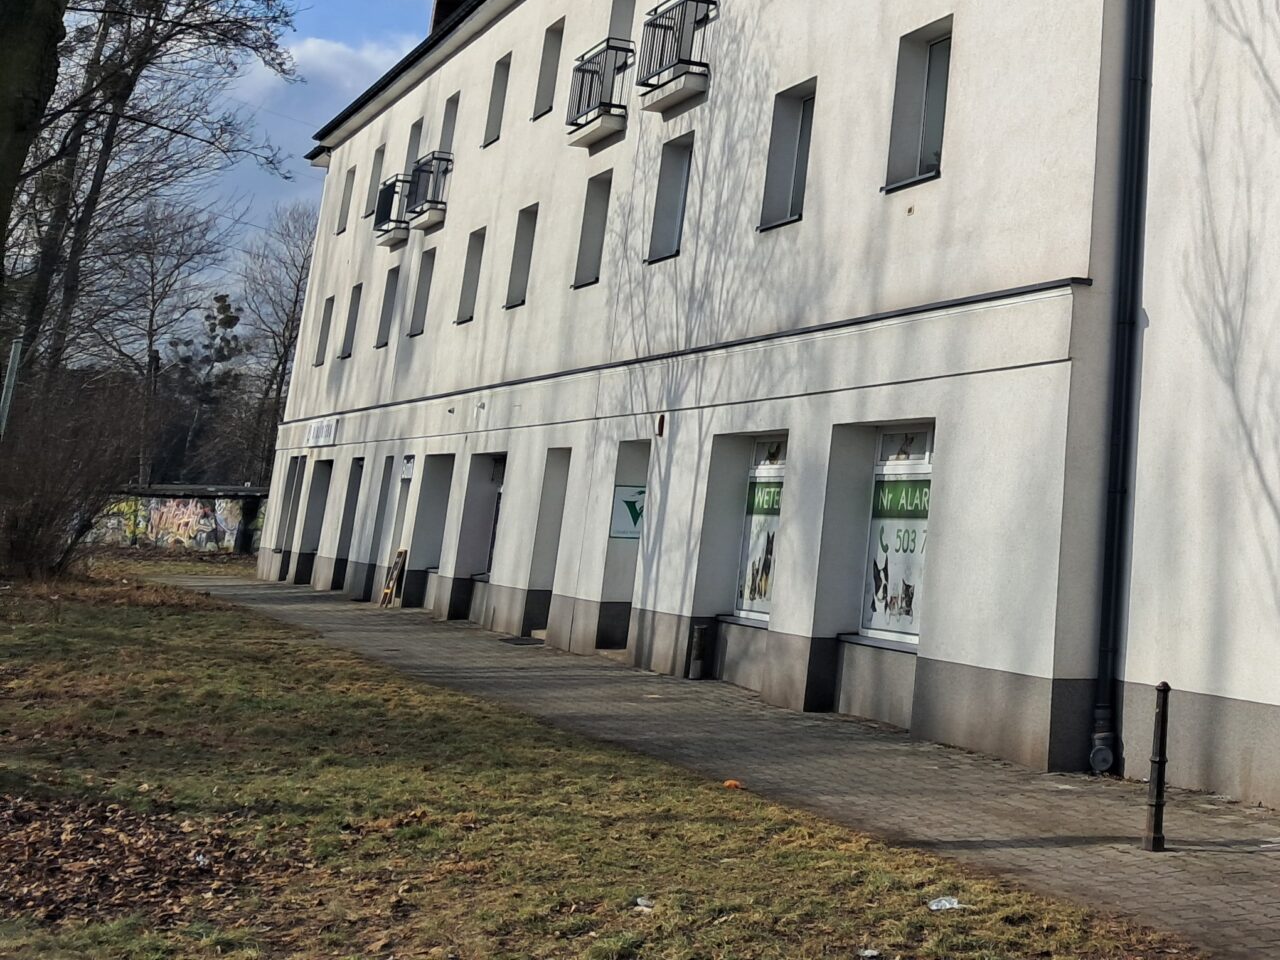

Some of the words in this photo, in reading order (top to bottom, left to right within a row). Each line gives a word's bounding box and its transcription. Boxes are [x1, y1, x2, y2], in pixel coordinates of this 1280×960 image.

[754, 487, 783, 509] WETE
[878, 488, 893, 510] Nr
[894, 528, 917, 553] 503
